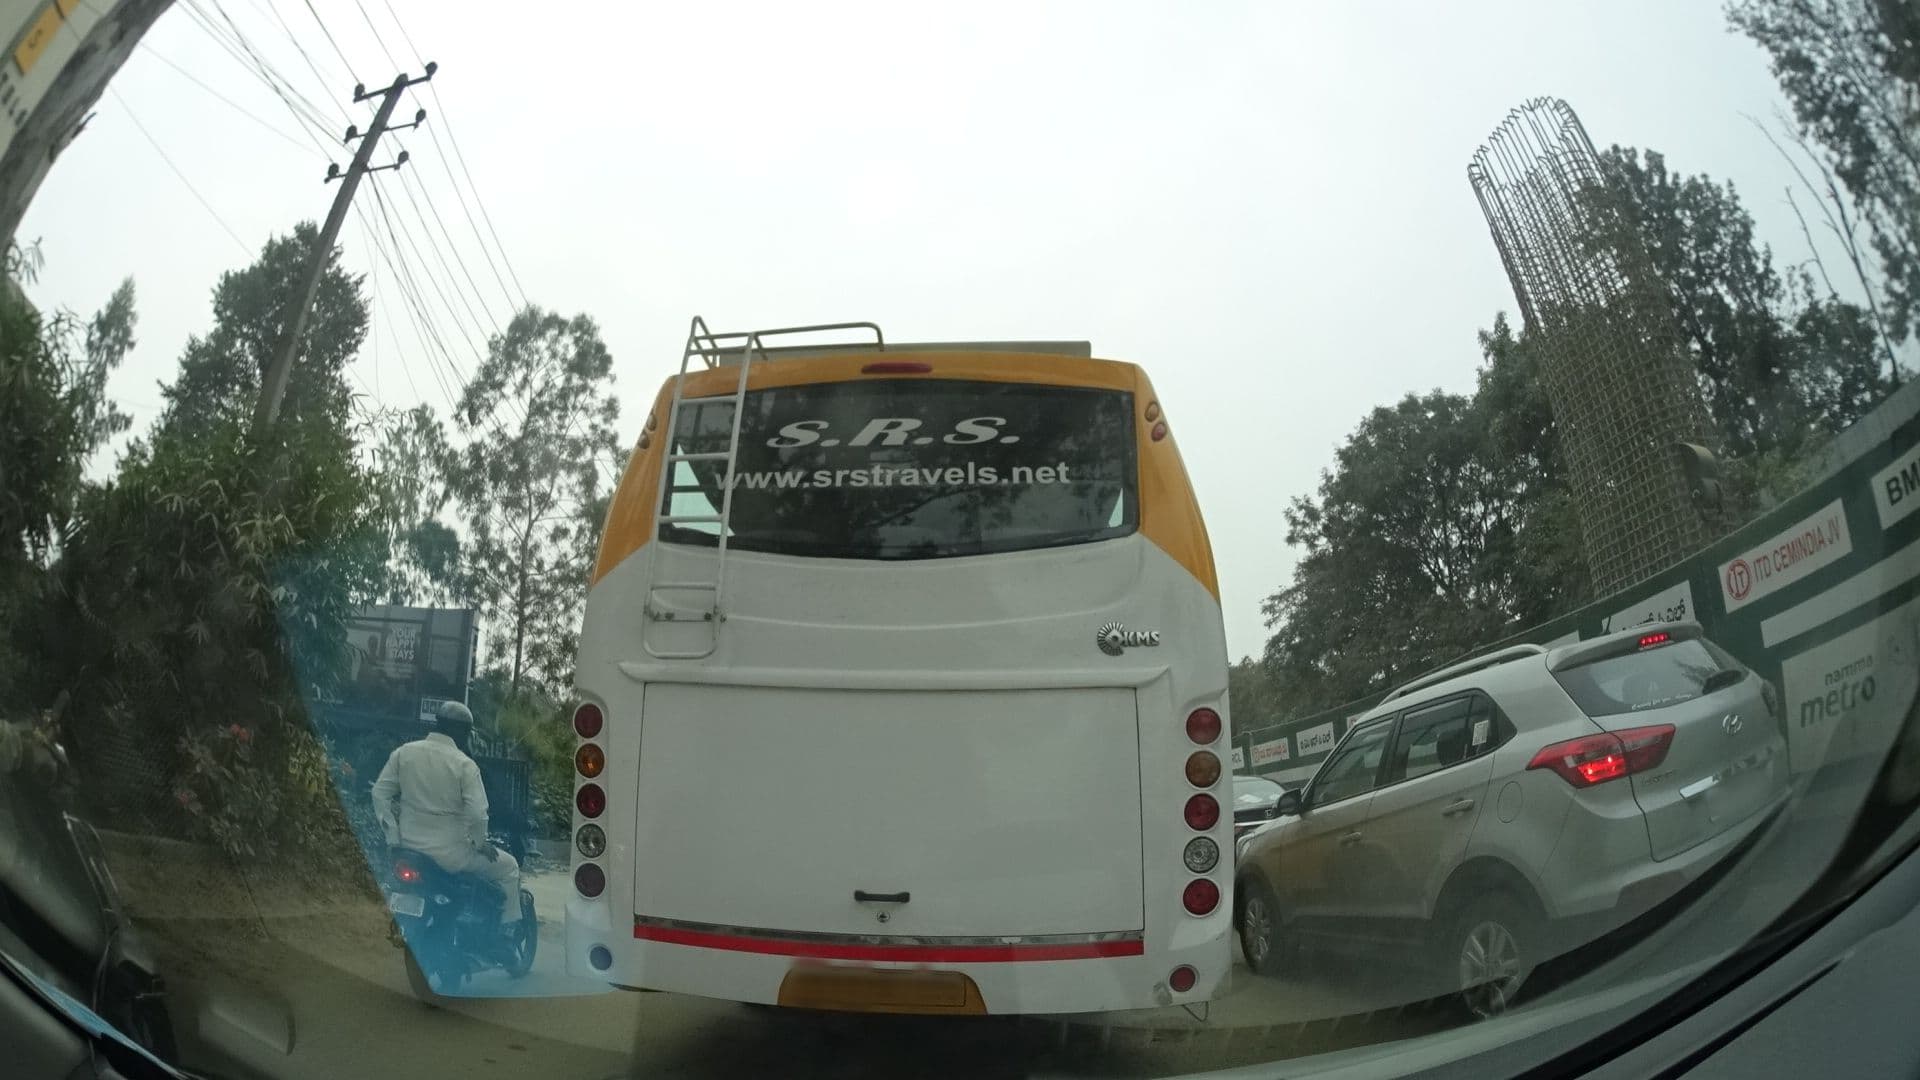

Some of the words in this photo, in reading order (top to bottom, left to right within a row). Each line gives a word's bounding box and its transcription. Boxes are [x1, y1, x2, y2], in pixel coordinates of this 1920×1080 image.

[715, 461, 1071, 490] www.srstravels.net
[1773, 525, 1827, 572] CEMINDIA
[1801, 675, 1876, 729] metro
